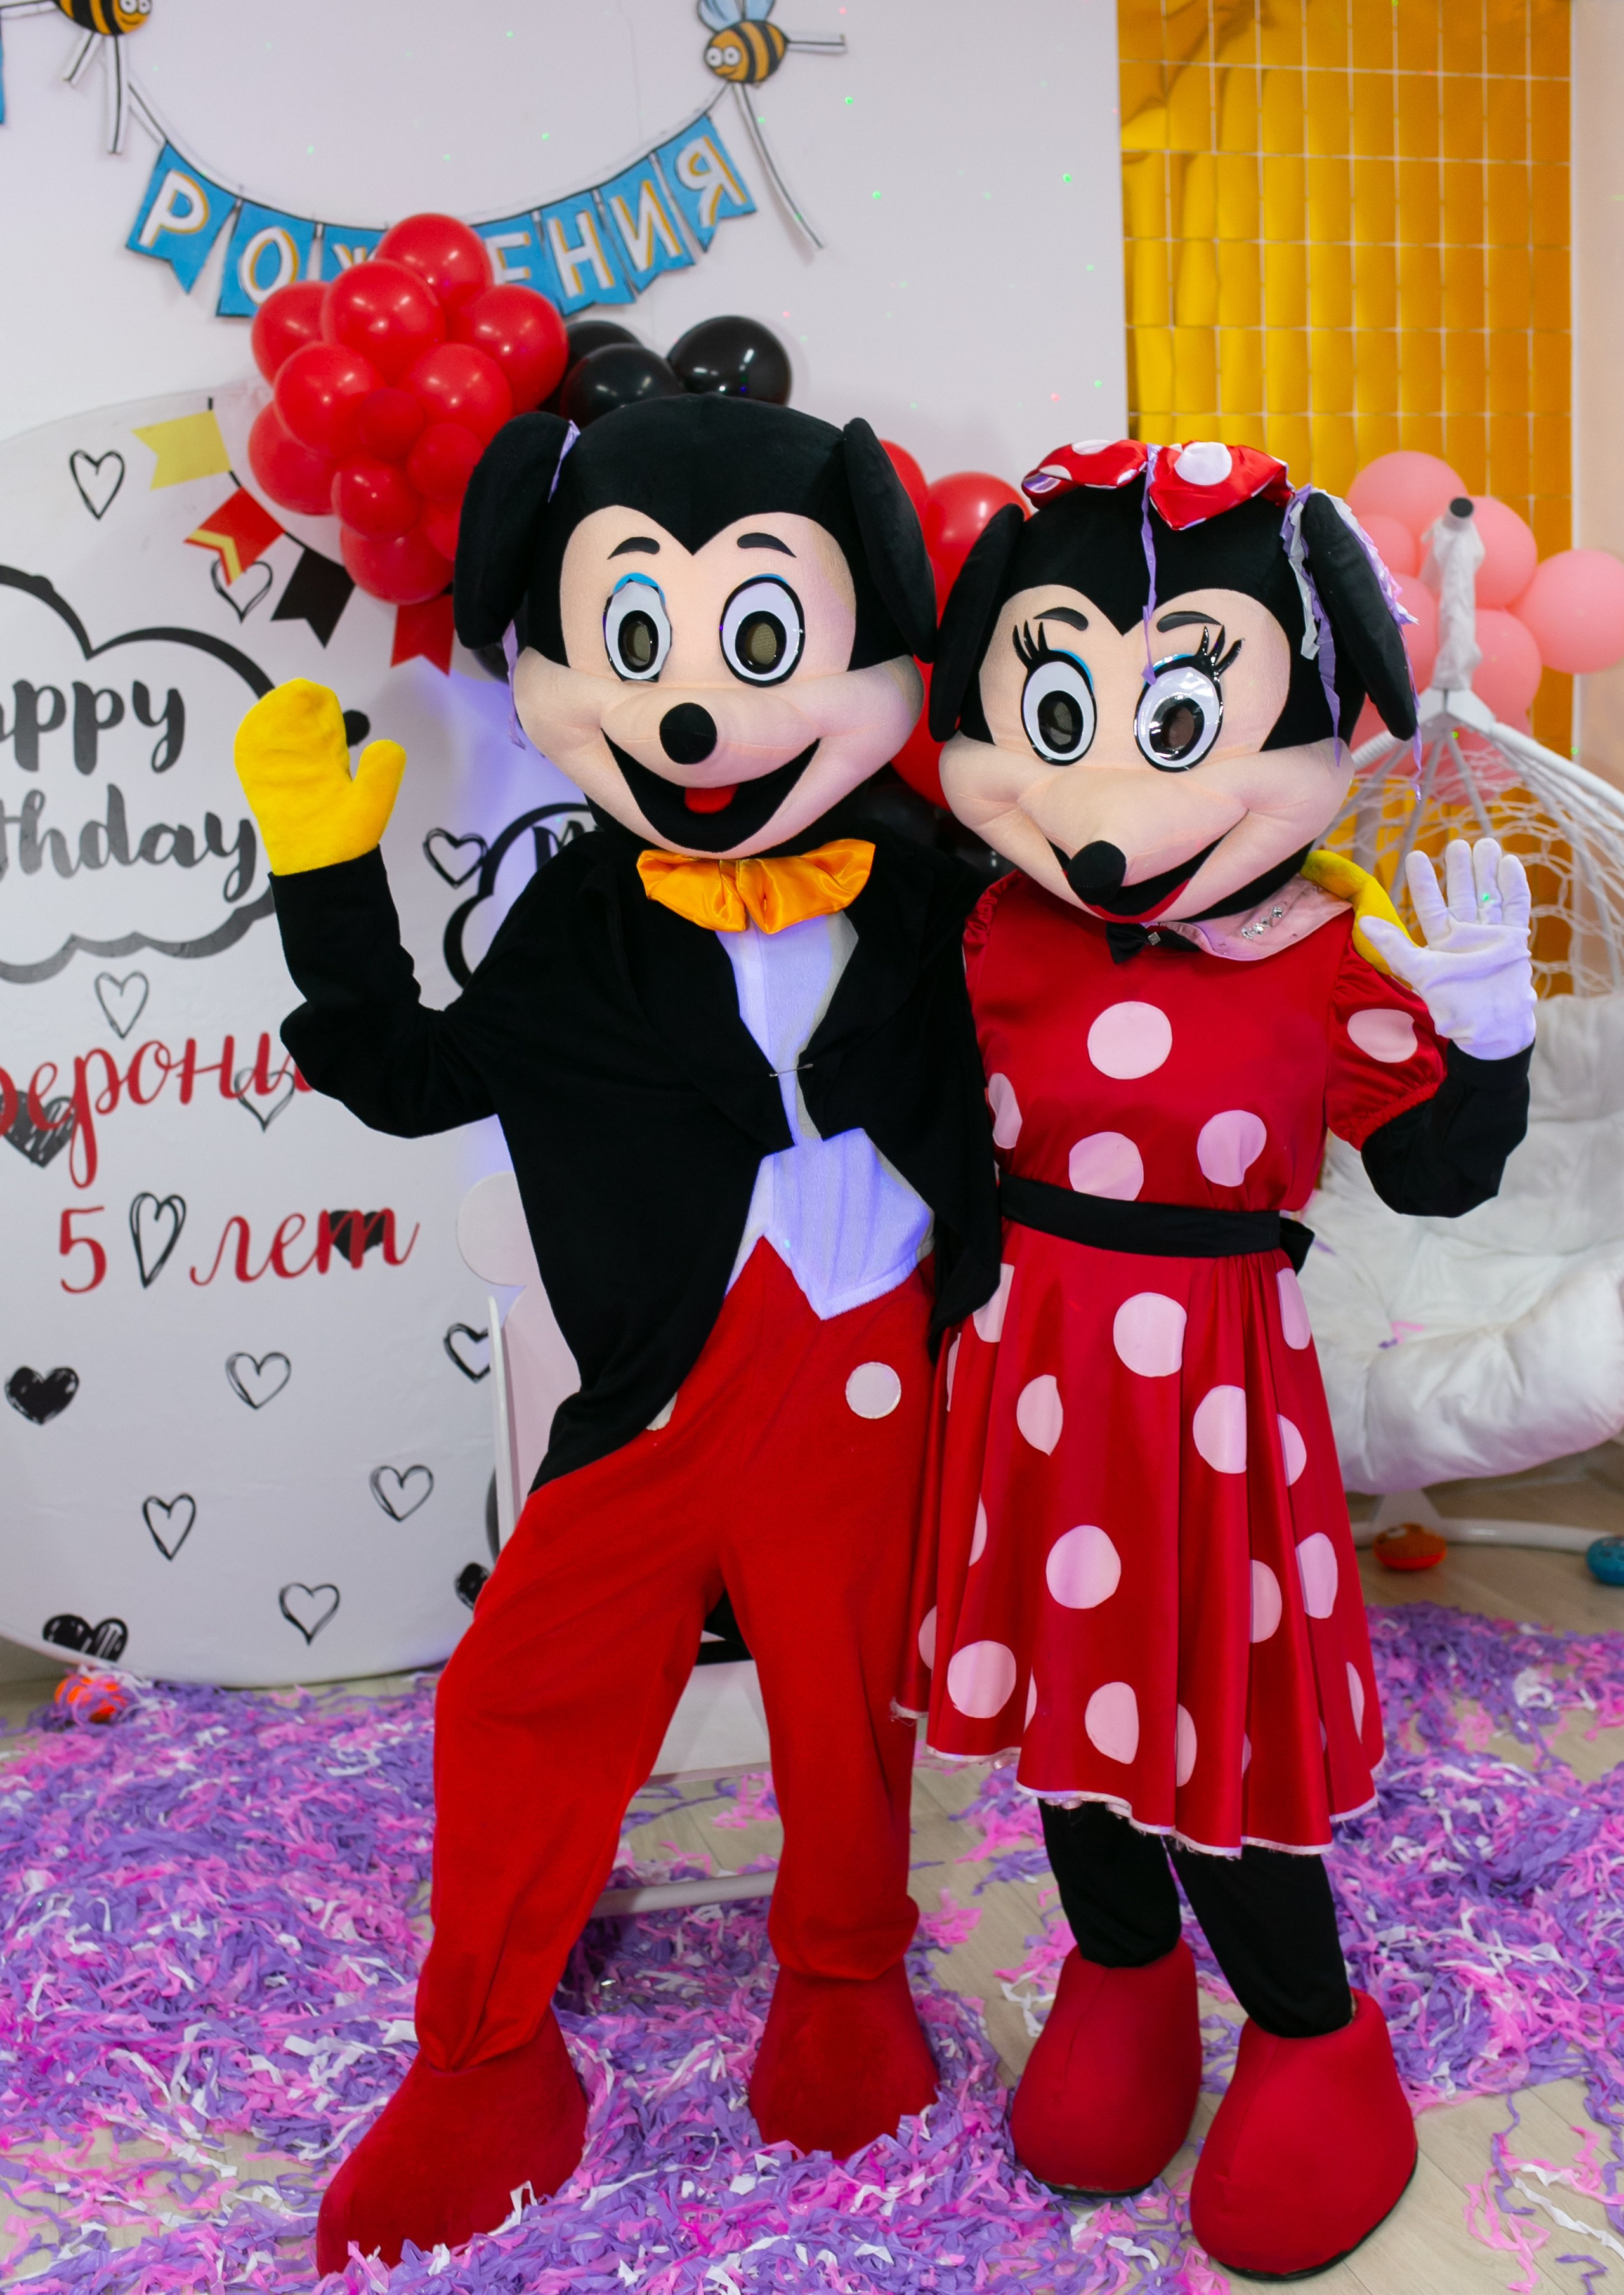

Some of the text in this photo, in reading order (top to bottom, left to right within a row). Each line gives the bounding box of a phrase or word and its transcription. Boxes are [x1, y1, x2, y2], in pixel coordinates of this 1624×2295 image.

[137, 135, 747, 305] РОЕНИЯ
[0, 679, 185, 775] ppy
[0, 1032, 313, 1189] ерони
[59, 1206, 420, 1293] 5 лет
